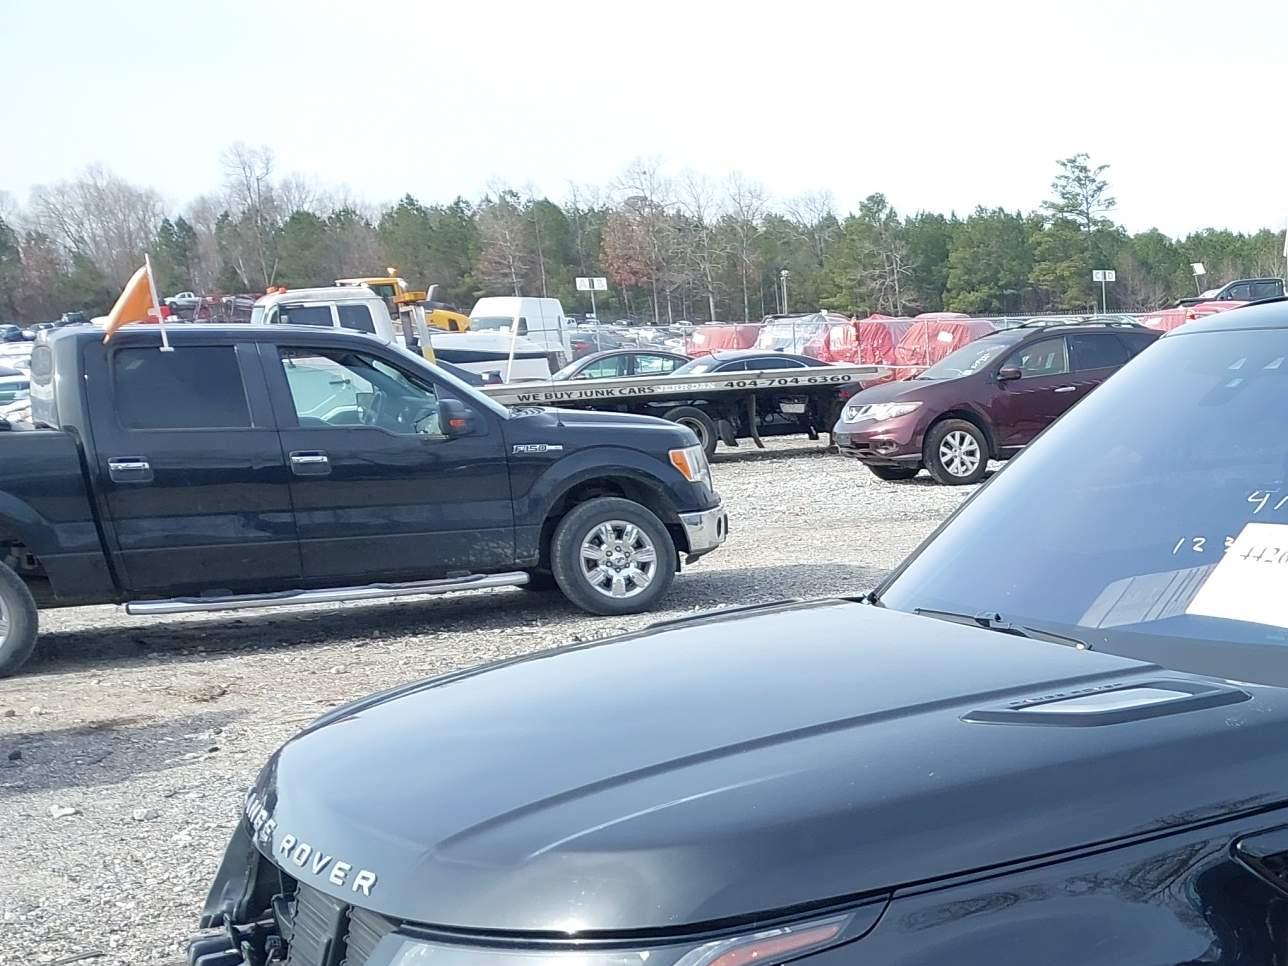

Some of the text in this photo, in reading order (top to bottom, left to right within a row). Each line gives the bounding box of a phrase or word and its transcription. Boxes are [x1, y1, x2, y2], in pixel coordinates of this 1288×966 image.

[517, 386, 655, 402] WE BUY JUNK CARS
[280, 833, 378, 897] ROVER
